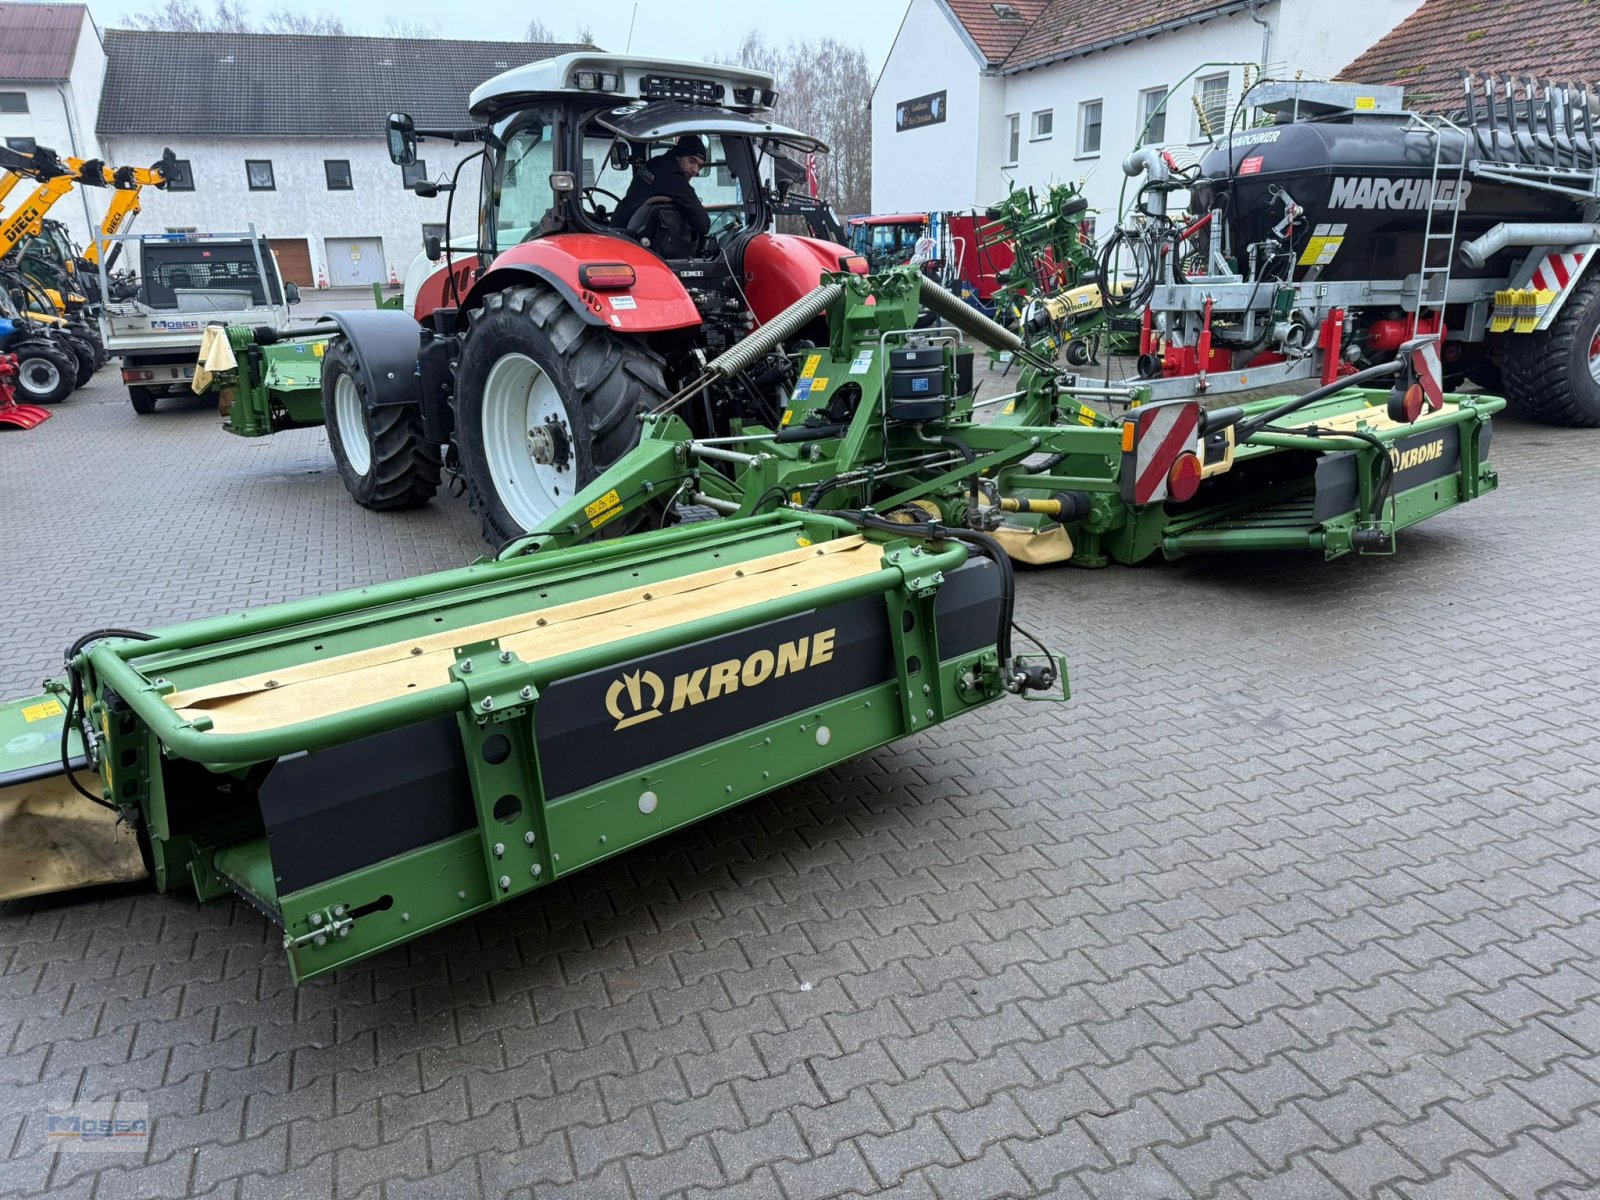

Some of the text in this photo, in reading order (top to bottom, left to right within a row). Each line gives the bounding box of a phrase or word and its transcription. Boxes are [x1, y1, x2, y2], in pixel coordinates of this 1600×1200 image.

[1327, 176, 1472, 211] MARCHNER
[107, 212, 122, 235] DIECI
[1399, 438, 1444, 471] KRONE
[669, 628, 836, 713] KRONE
